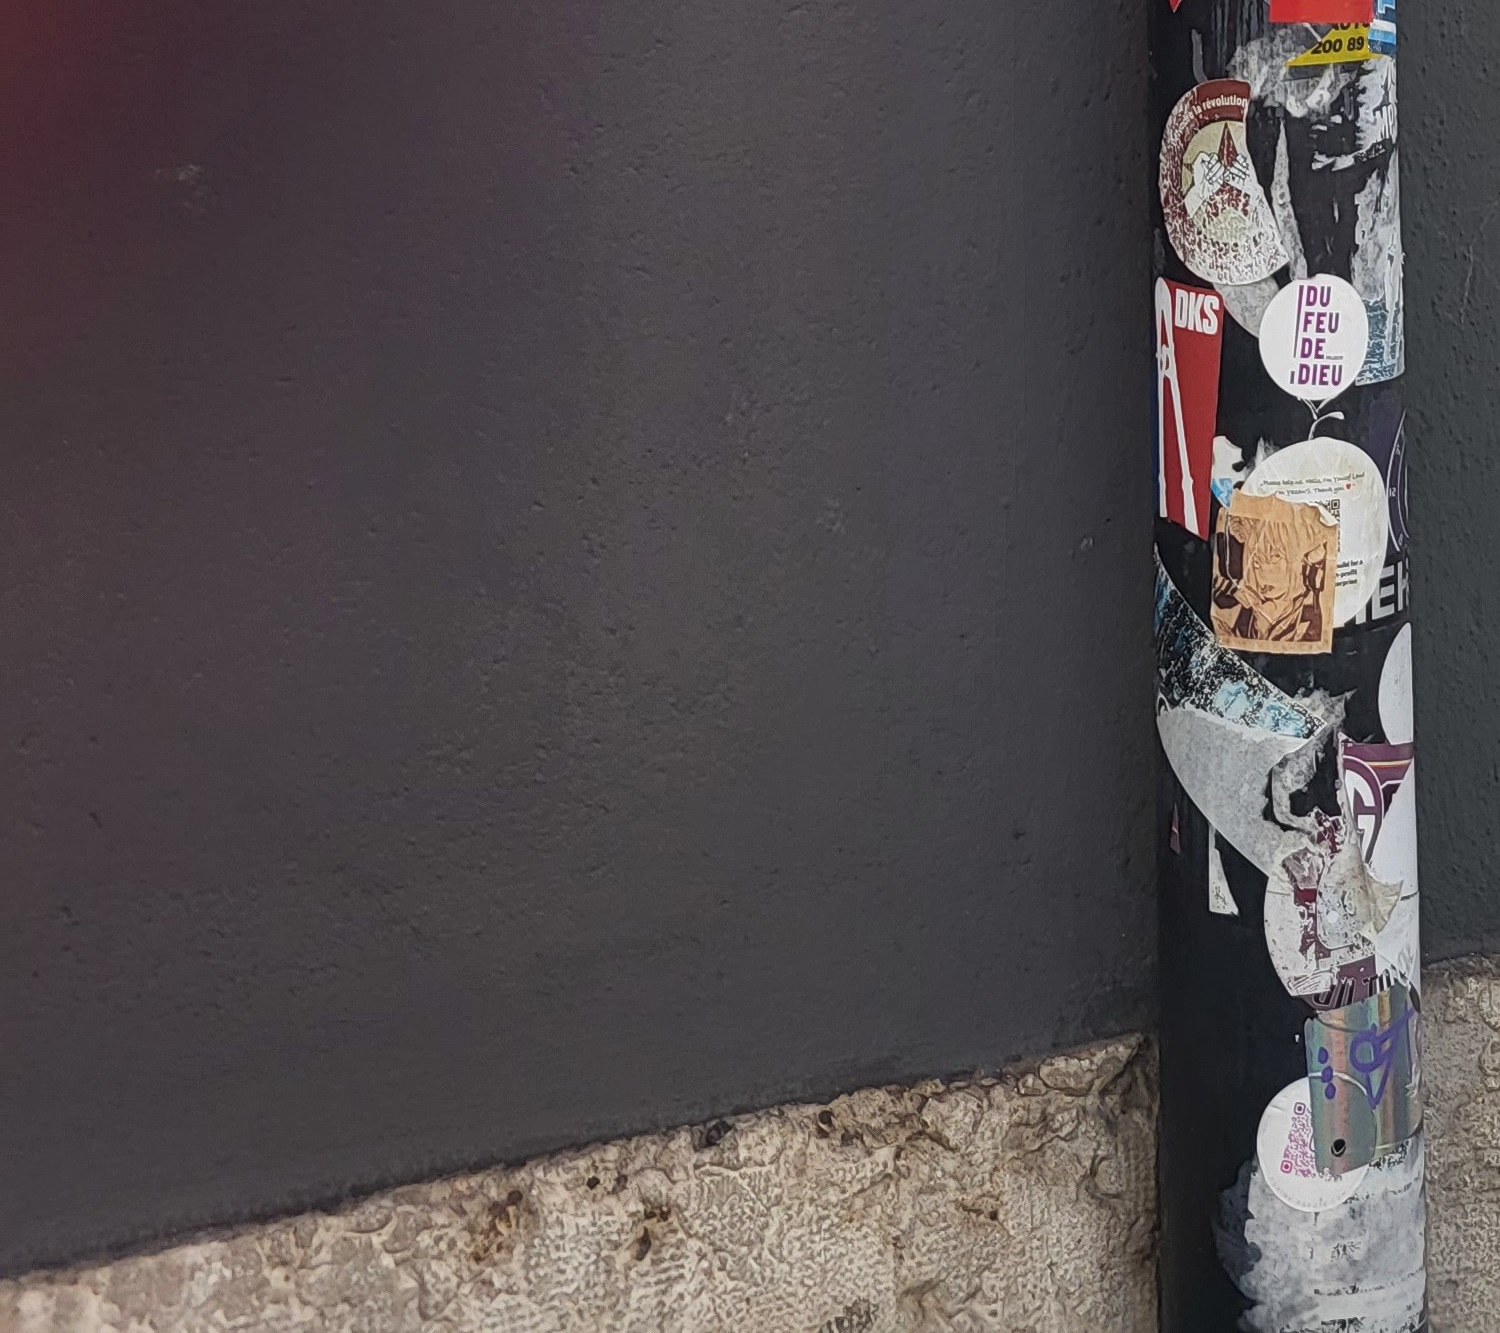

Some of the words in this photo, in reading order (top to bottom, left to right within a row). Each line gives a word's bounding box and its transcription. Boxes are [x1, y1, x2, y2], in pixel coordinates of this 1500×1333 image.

[1347, 35, 1365, 52] 89
[1305, 285, 1332, 308] DU
[1174, 288, 1221, 335] DKS
[1303, 311, 1340, 334] FEU
[1300, 337, 1327, 360] DE
[1298, 363, 1343, 386] DIEU
